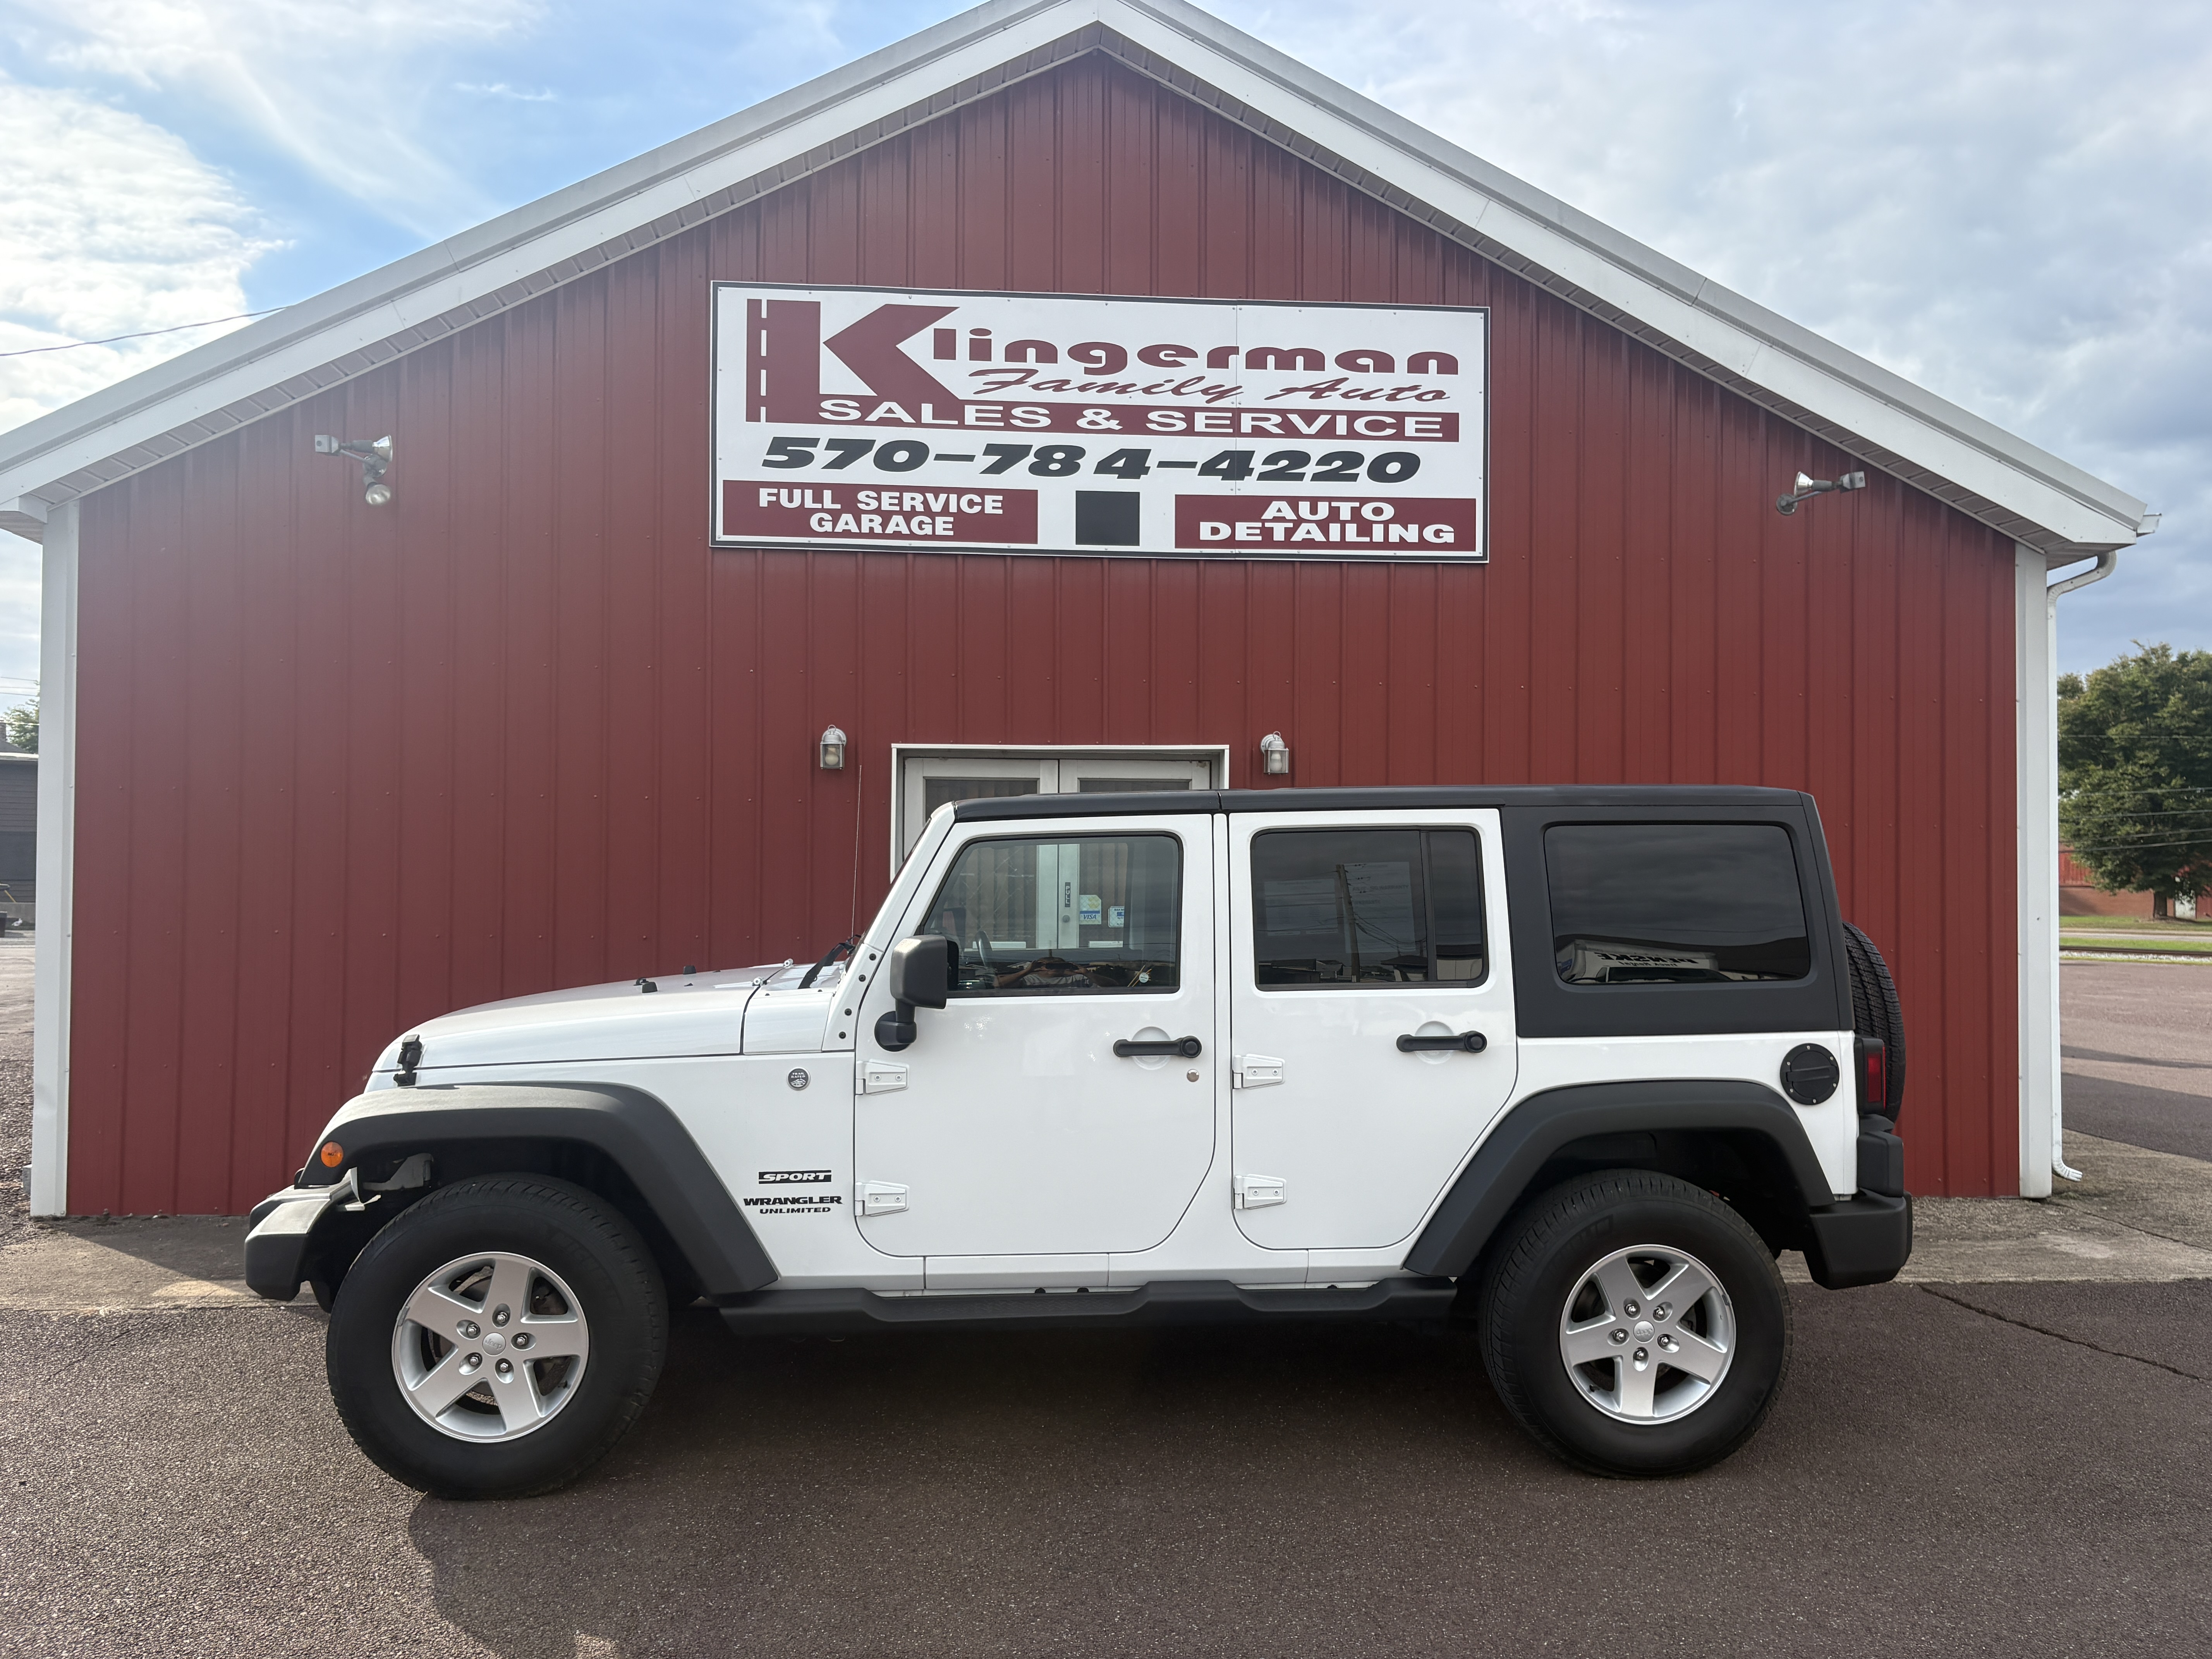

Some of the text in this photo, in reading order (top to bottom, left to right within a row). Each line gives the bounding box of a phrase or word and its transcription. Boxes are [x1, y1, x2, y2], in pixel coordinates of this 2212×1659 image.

[746, 299, 1458, 422] Klingerman
[968, 368, 1450, 404] Family Auto
[818, 399, 1443, 437] SALES & SERVICE
[761, 436, 1421, 483] 570-784-4220
[759, 488, 1003, 514] FULL SERVICE
[1261, 501, 1395, 521] AUTO
[809, 513, 954, 536] GARAGE
[1199, 521, 1455, 544] DETAILING
[761, 1172, 831, 1182] SPORT
[744, 1196, 843, 1206] WRANGLER
[485, 1338, 503, 1349] Jeep
